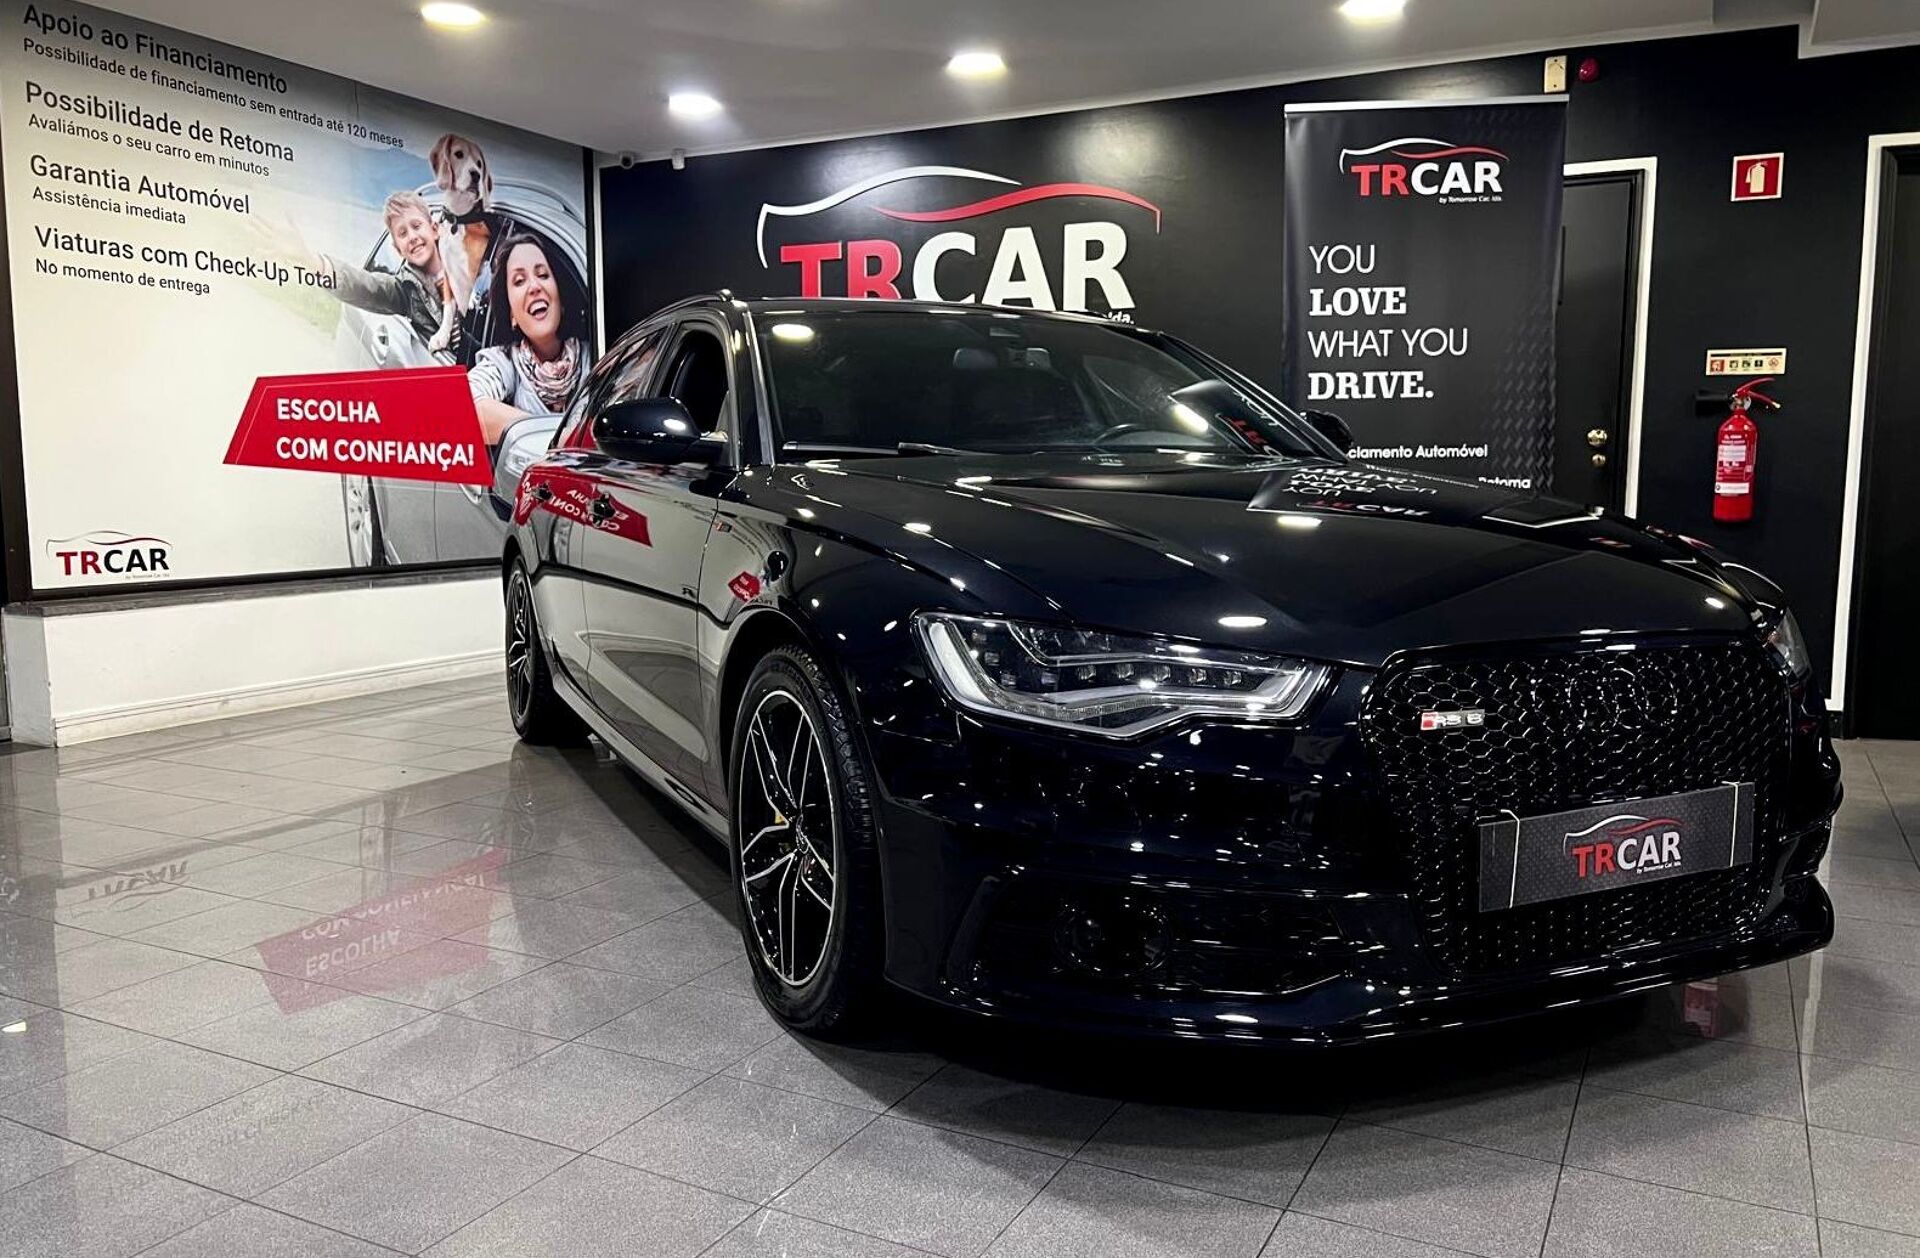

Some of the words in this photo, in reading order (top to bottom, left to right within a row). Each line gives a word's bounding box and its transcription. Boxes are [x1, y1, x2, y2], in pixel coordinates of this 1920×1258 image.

[23, 4, 93, 40] Apoio
[101, 28, 129, 50] ao
[136, 33, 288, 94] Financiamento
[23, 37, 126, 76] Possibilidade
[130, 65, 147, 81] de
[152, 70, 246, 107] financiamento
[250, 99, 276, 115] sem
[279, 107, 323, 127] entrada
[326, 118, 344, 133] até
[348, 123, 367, 138] 120
[369, 130, 404, 148] meses
[26, 81, 182, 136] Possibilidade
[188, 120, 213, 143] de
[220, 127, 294, 162] Retoma
[28, 113, 108, 142] Avaliámos
[113, 134, 122, 145] o
[126, 138, 152, 152] seu
[156, 144, 191, 160] carro
[195, 153, 215, 165] em
[219, 156, 270, 177] minutos
[30, 154, 130, 192] Garantia
[138, 175, 249, 214] Automóvel
[1351, 161, 1503, 196] TRCAR
[32, 186, 121, 213] Assistência
[126, 201, 186, 224] imediata
[35, 225, 133, 259] Viaturas
[142, 246, 188, 268] com
[195, 250, 289, 286] Check-Up
[294, 266, 337, 290] Total
[780, 221, 1136, 312] TRCAR
[1308, 244, 1375, 273] YOU
[36, 258, 58, 274] No
[62, 264, 134, 284] momento
[138, 272, 155, 287] de
[159, 276, 210, 296] entrega
[1309, 287, 1407, 316] LOVE
[1307, 329, 1394, 358] WHAT
[1401, 327, 1468, 356] YOU
[1307, 371, 1434, 400] DRIVE.
[277, 398, 381, 424] ESCOLHA
[276, 437, 328, 460] COM
[334, 438, 475, 471] CONFIANÇA!
[1348, 445, 1413, 459] ciamento
[1415, 443, 1488, 459] Automóvel
[56, 548, 170, 576] TRCAR
[1573, 831, 1681, 877] TRCAR
